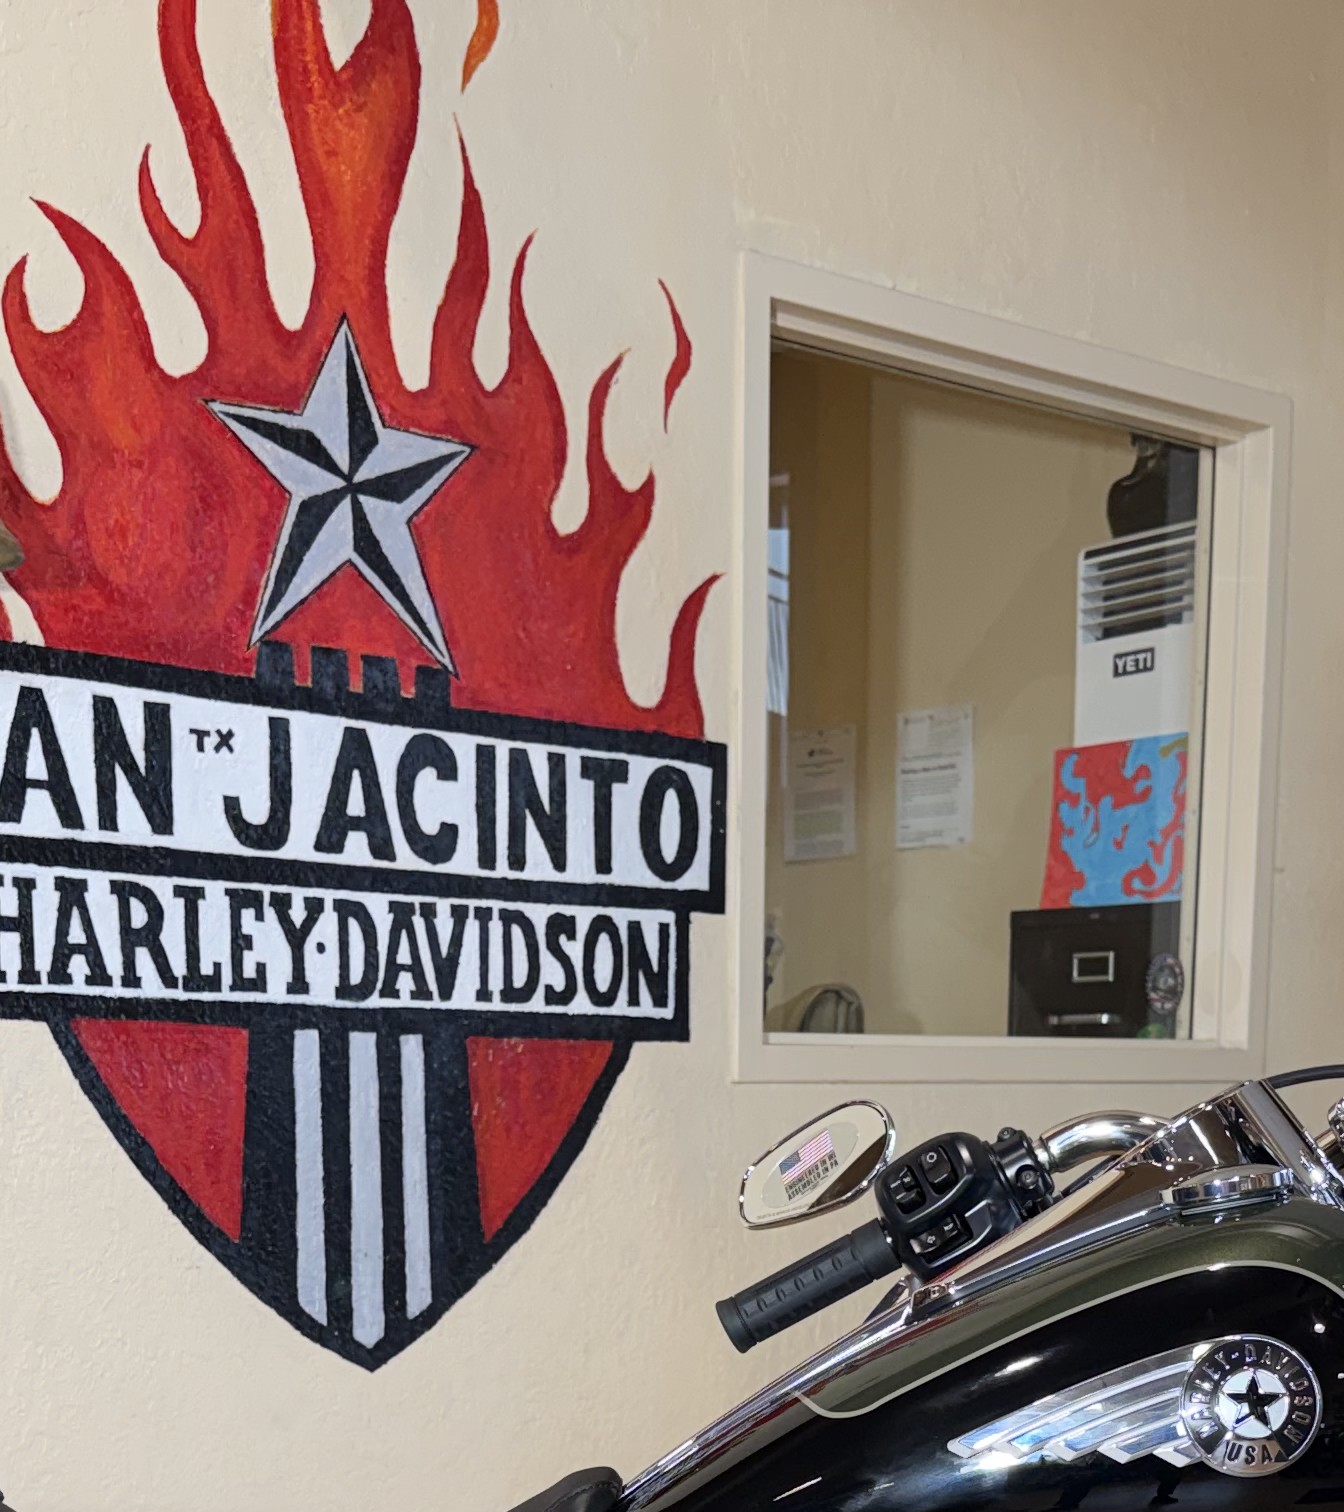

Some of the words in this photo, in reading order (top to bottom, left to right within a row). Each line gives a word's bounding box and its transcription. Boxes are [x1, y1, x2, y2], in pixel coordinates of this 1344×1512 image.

[1115, 651, 1152, 674] YETI
[189, 727, 235, 755] TX
[222, 717, 700, 883] JACINTO
[786, 1171, 821, 1201] ASSEMBLED
[1189, 1342, 1314, 1445] HARLEY-DAVIDSON
[1227, 1443, 1274, 1466] USA
